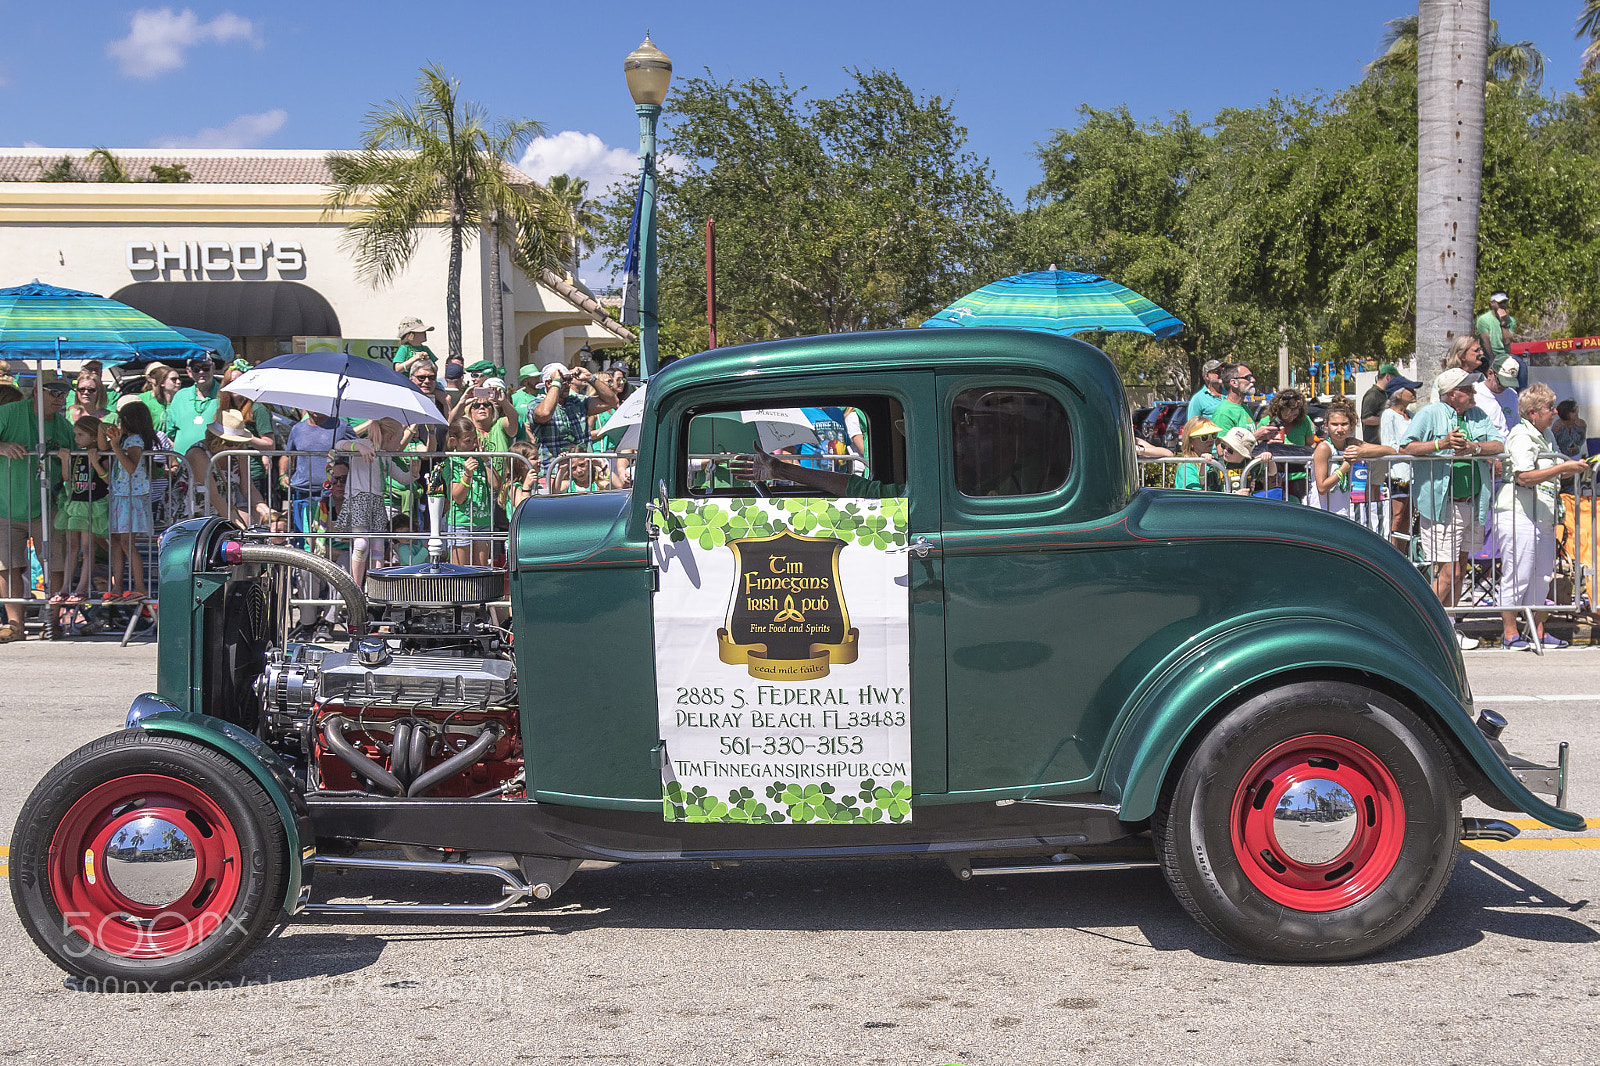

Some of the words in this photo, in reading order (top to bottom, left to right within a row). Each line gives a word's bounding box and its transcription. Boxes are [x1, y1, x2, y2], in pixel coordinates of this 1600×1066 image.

[126, 237, 303, 270] CHICO'S
[1546, 340, 1574, 350] WEST
[769, 554, 803, 574] Tim
[744, 571, 829, 594] Finnegans
[750, 624, 766, 633] Fine
[768, 624, 787, 633] Food
[788, 624, 804, 633] and
[805, 624, 831, 635] Spirits
[676, 687, 724, 705] 2885
[731, 688, 749, 709] S.
[720, 736, 864, 755] 561-330-3153
